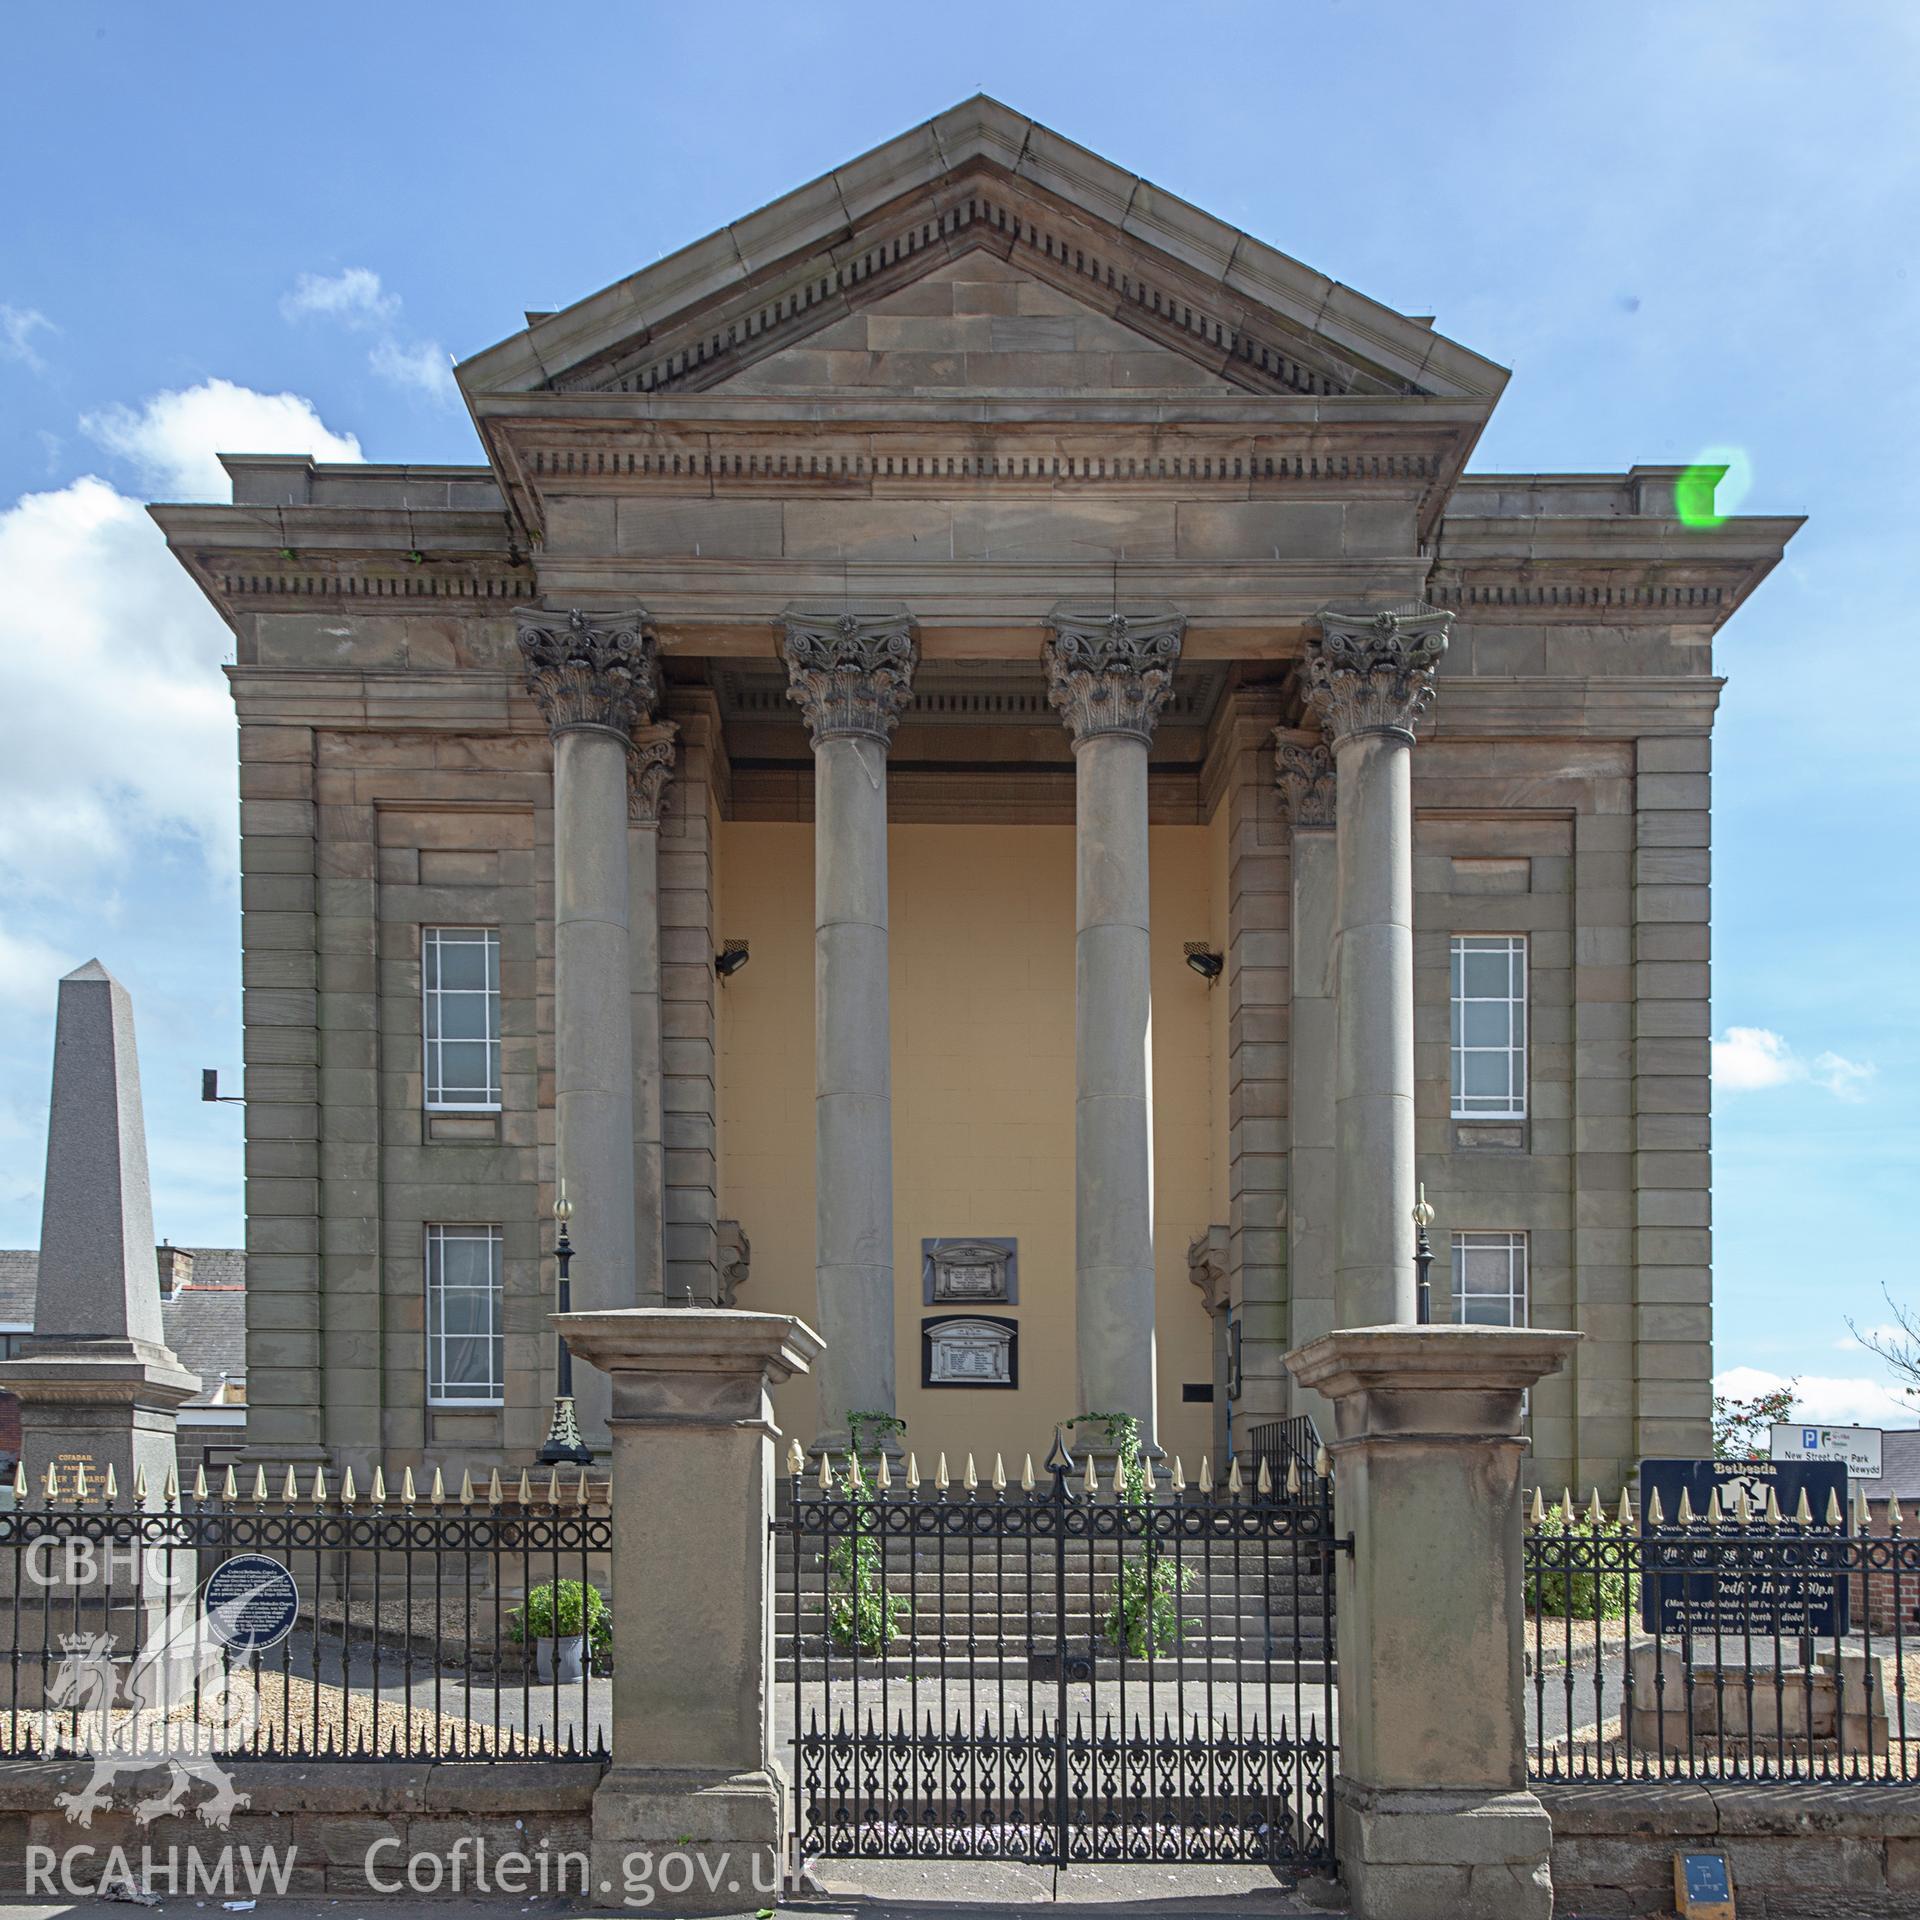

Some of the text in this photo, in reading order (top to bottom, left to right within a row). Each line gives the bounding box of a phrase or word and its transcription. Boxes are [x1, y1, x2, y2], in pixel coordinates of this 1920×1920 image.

[1784, 1451, 1870, 1463] New Street Car Park
[1713, 1462, 1778, 1476] Bethesda
[1848, 1465, 1880, 1476] Newydd
[41, 1475, 67, 1483] RER
